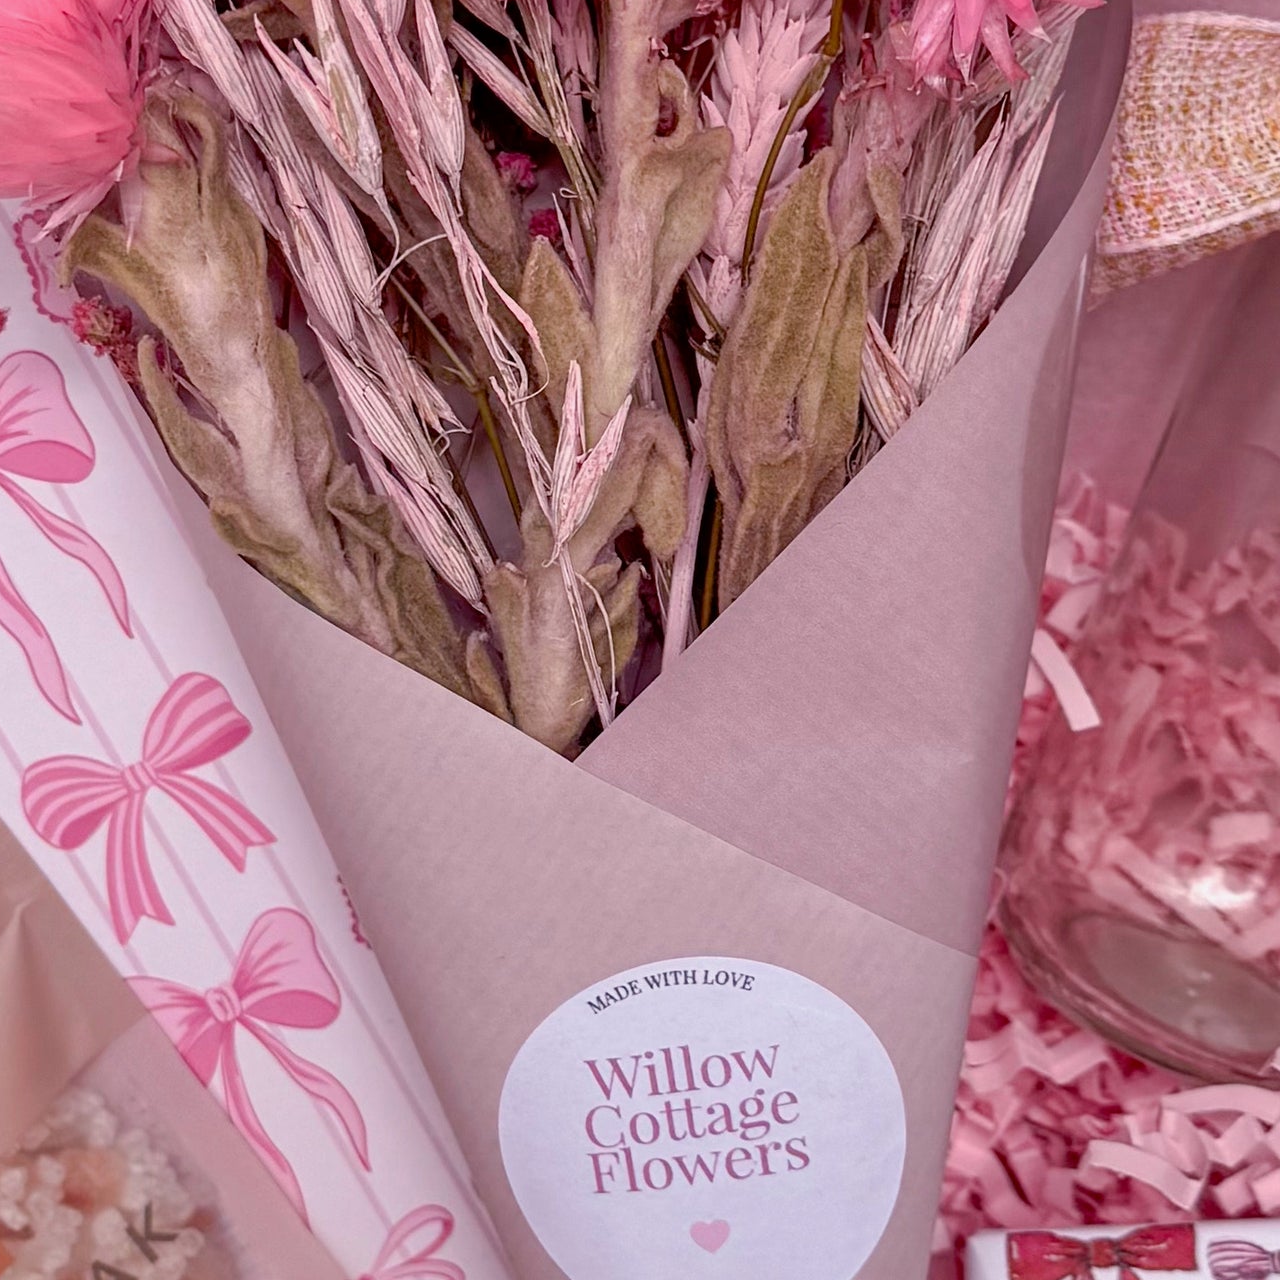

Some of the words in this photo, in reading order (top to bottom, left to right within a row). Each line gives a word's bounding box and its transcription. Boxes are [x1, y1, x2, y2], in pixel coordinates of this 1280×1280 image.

[587, 980, 642, 1014] MADE
[644, 970, 697, 990] WITH
[702, 970, 755, 991] LOVE
[584, 1044, 781, 1101] Willow
[585, 1089, 800, 1149] Cottage
[587, 1136, 811, 1194] Flowers
